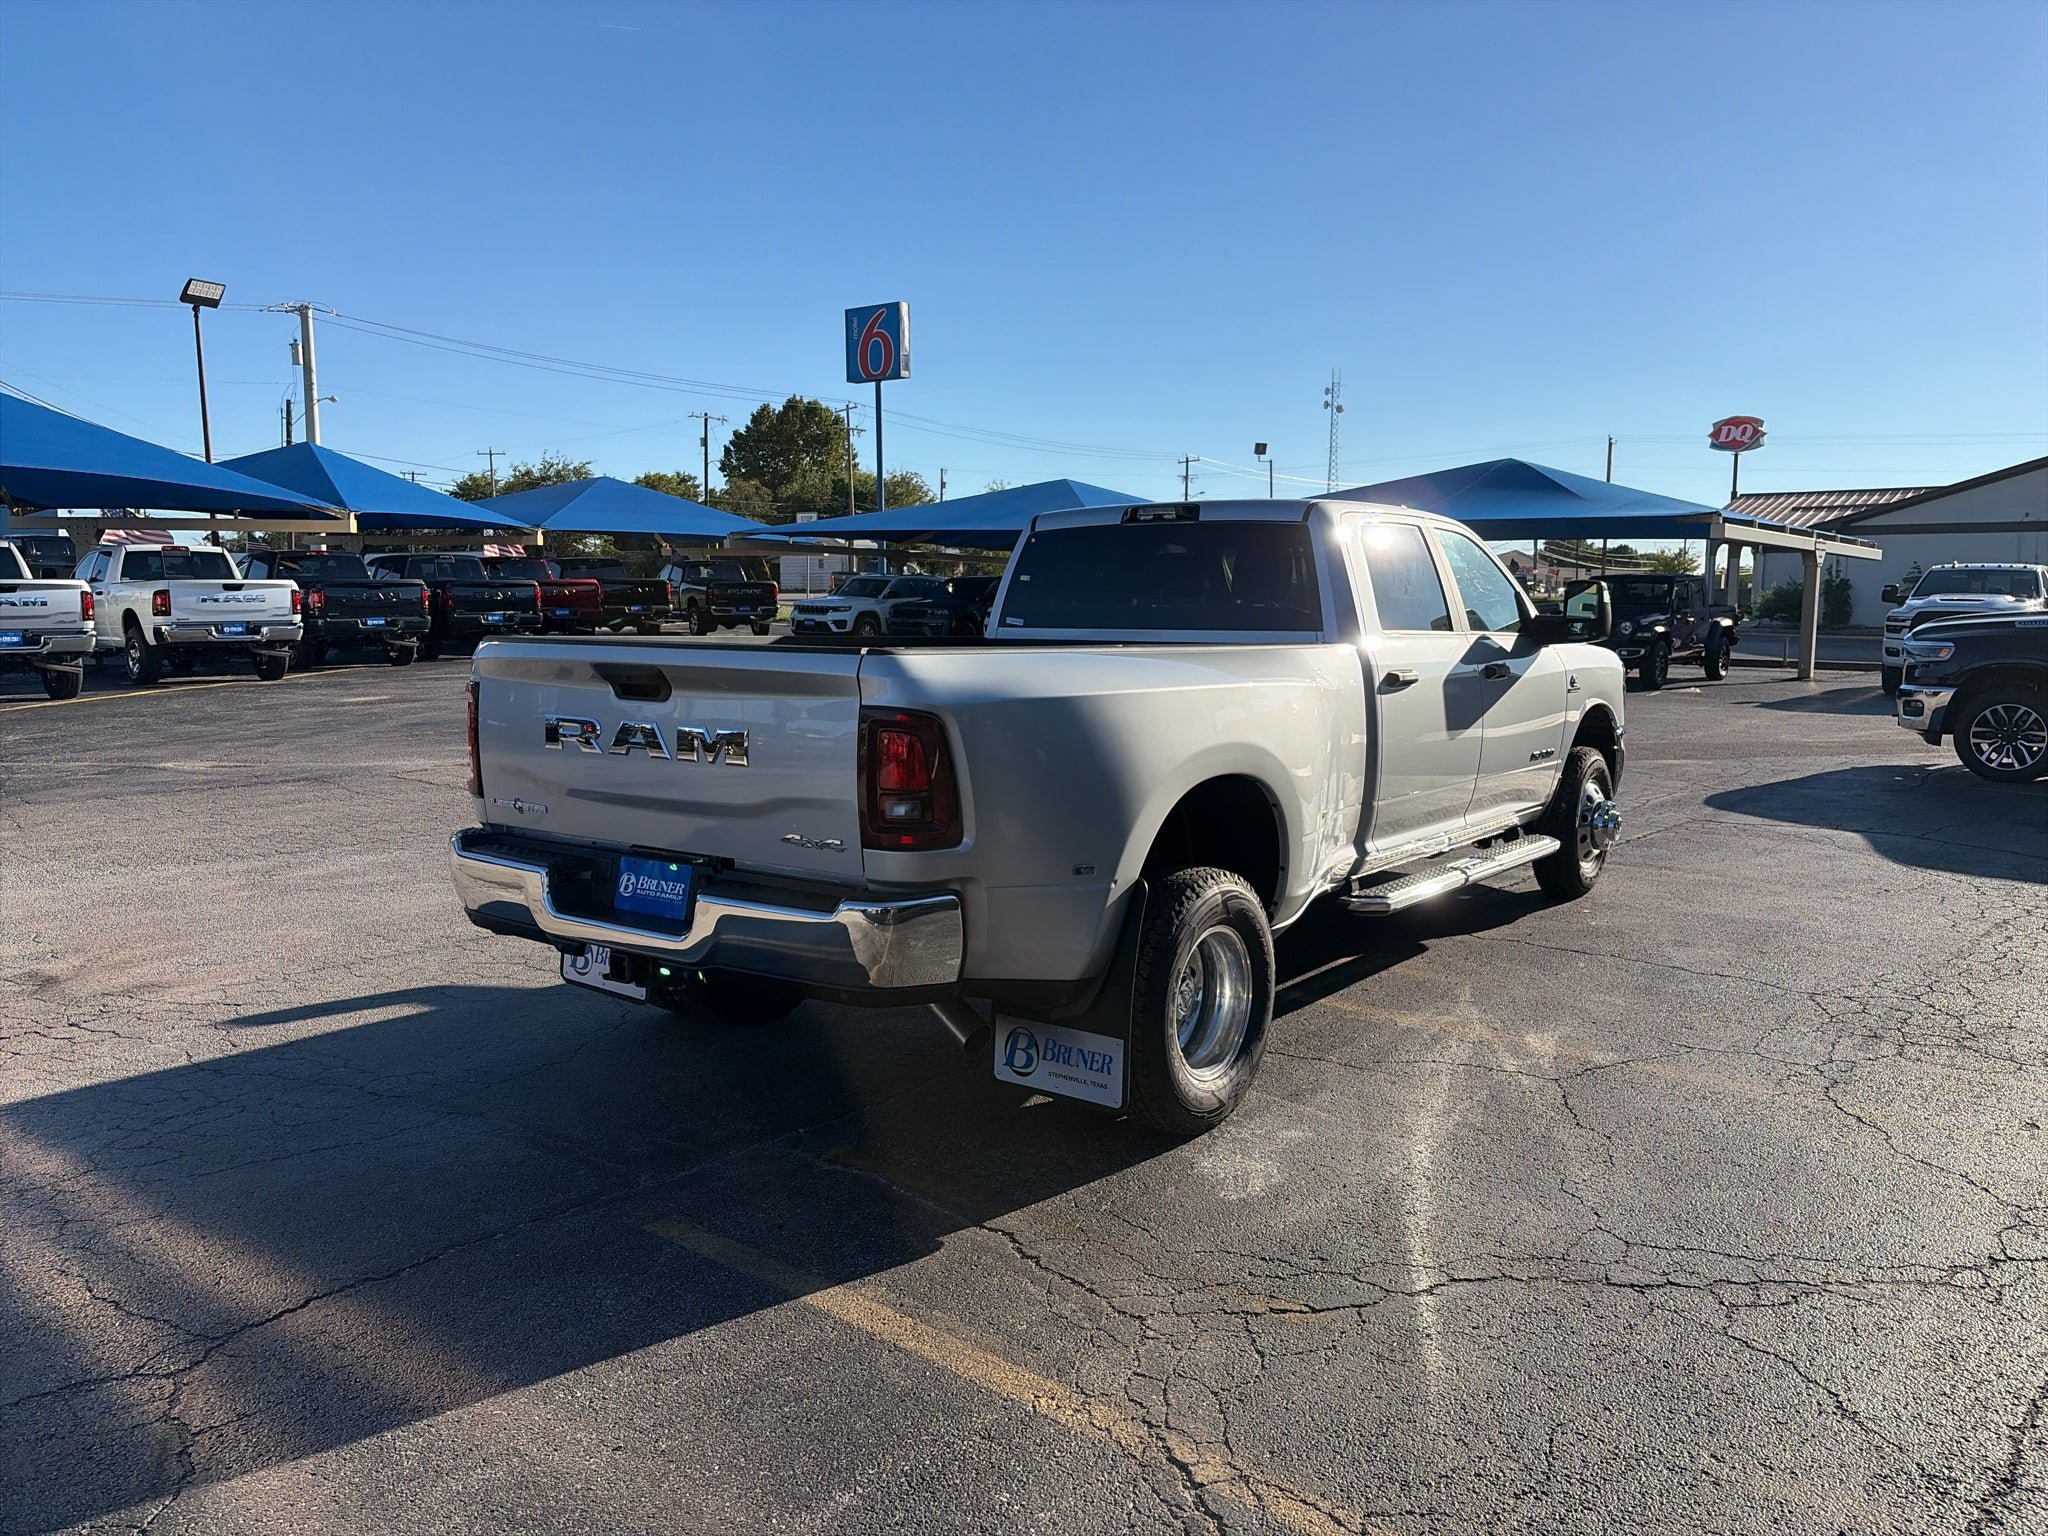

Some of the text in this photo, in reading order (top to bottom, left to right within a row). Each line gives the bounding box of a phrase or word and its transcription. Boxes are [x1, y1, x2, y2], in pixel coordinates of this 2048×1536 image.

[857, 308, 895, 378] 6
[1718, 423, 1754, 443] DQ
[0, 596, 48, 607] AM
[544, 713, 750, 768] RAM
[636, 889, 656, 897] AUTO
[656, 891, 683, 901] FAMILY
[637, 875, 685, 895] BRUNER
[1041, 1037, 1113, 1076] BRUNER
[1047, 1071, 1108, 1090] STEPHENVILLE, TEXAS
